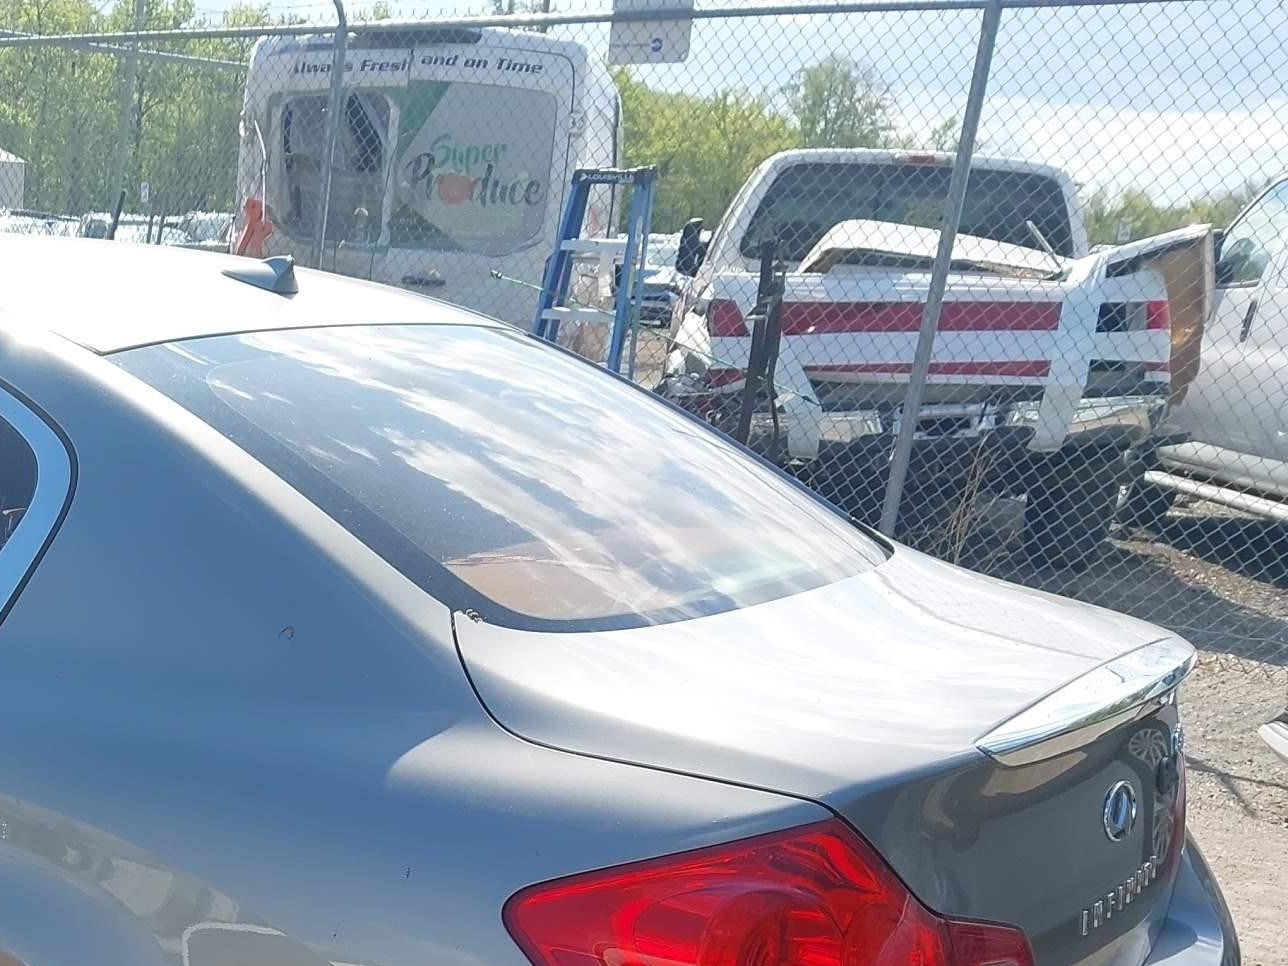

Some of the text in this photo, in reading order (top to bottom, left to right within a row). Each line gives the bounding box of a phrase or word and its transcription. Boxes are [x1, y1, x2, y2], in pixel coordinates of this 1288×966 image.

[360, 57, 410, 72] Fresh
[421, 55, 459, 66] and
[464, 59, 488, 69] on
[496, 58, 543, 74] Time
[430, 132, 508, 175] Super
[1080, 856, 1157, 935] INFINITI
